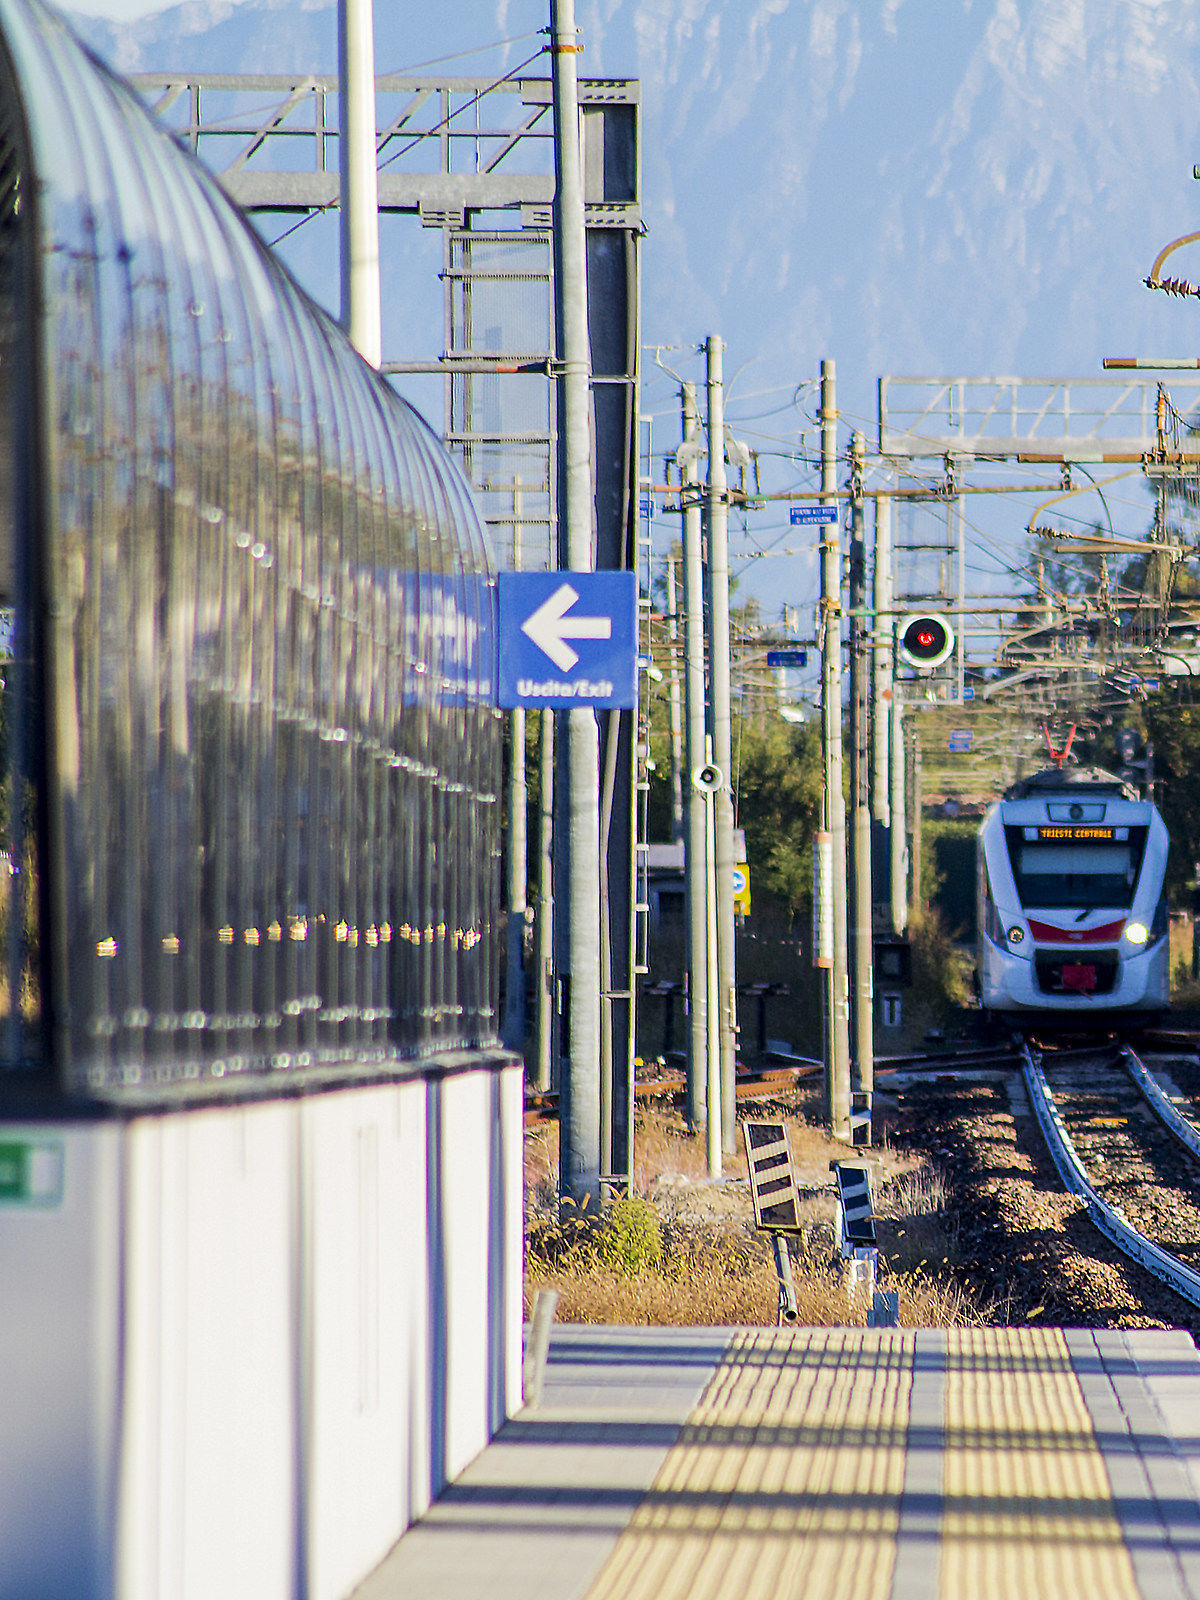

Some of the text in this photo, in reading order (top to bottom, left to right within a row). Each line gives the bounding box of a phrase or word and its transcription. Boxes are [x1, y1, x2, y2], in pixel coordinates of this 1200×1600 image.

[517, 679, 613, 697] Uscita/Exit
[1041, 828, 1112, 838] TRIESTE CENTRALE
